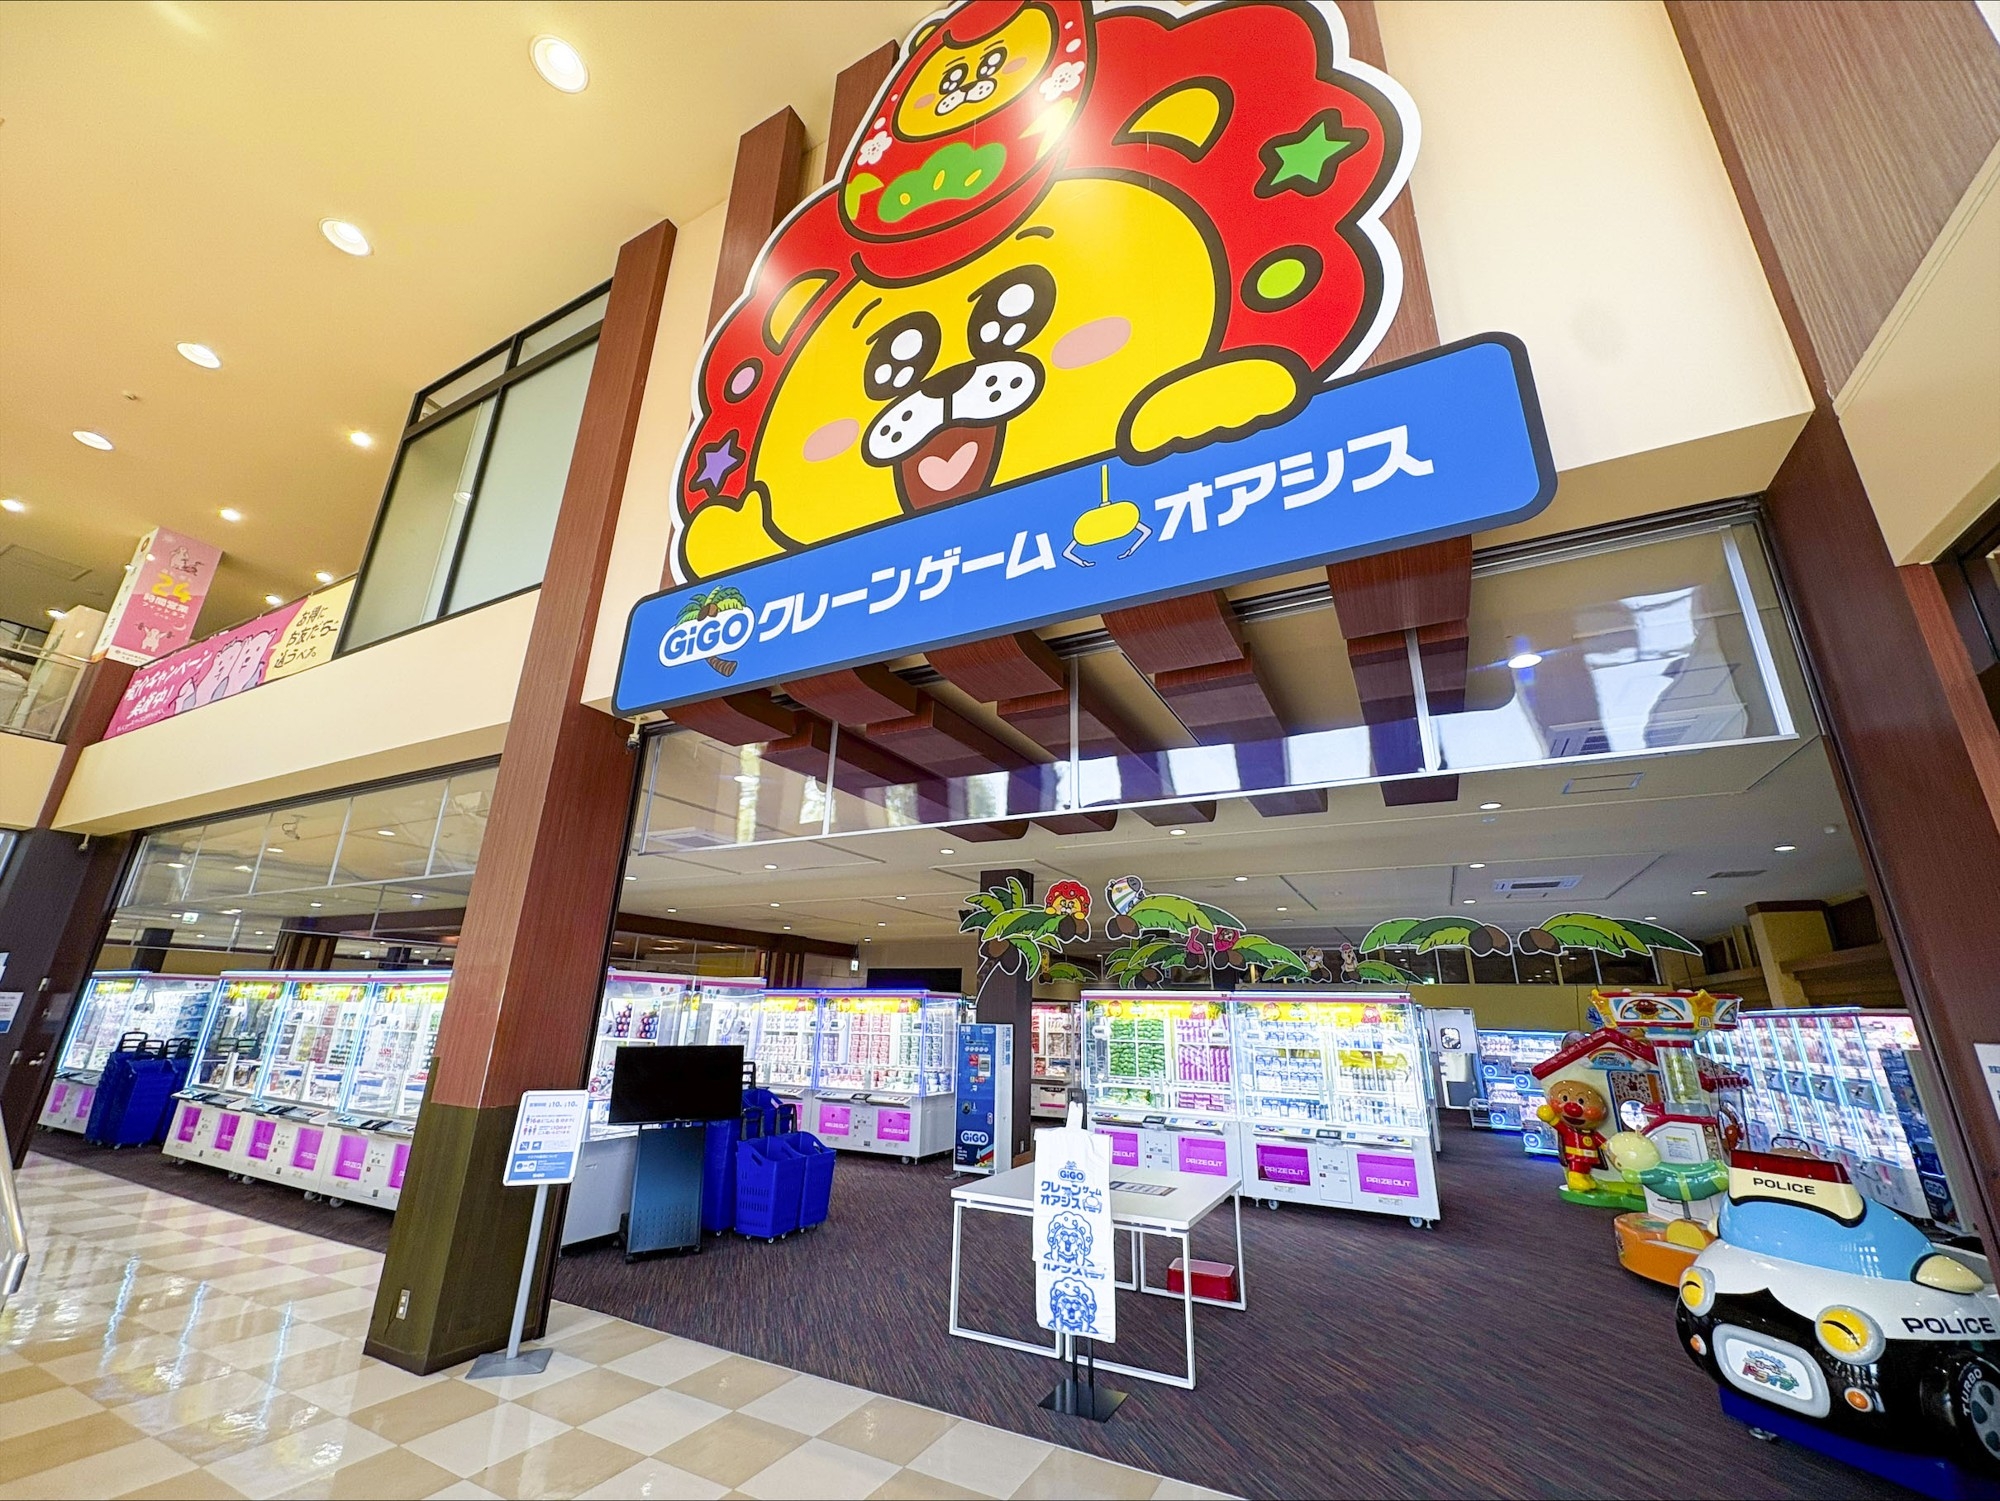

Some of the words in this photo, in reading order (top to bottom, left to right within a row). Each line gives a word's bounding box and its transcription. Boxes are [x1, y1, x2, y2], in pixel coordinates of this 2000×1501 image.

[664, 612, 748, 659] GiGO
[758, 531, 1056, 642] クレーンゲーム
[1154, 425, 1434, 542] オアシス
[152, 573, 192, 603] 24
[296, 605, 328, 627] お得に
[962, 1132, 987, 1143] GiGO
[1185, 1157, 1208, 1166] PRIZE
[1060, 1170, 1084, 1180] GiGO
[1264, 1165, 1288, 1174] PRIZE
[1288, 1168, 1305, 1176] OUT
[1365, 1176, 1392, 1186] PRIZE
[1393, 1179, 1412, 1187] OUT
[1753, 1177, 1816, 1195] POLICE
[1041, 1194, 1081, 1210] オアシス
[1901, 1317, 1996, 1335] POLICE
[1961, 1368, 1982, 1416] TURBO
